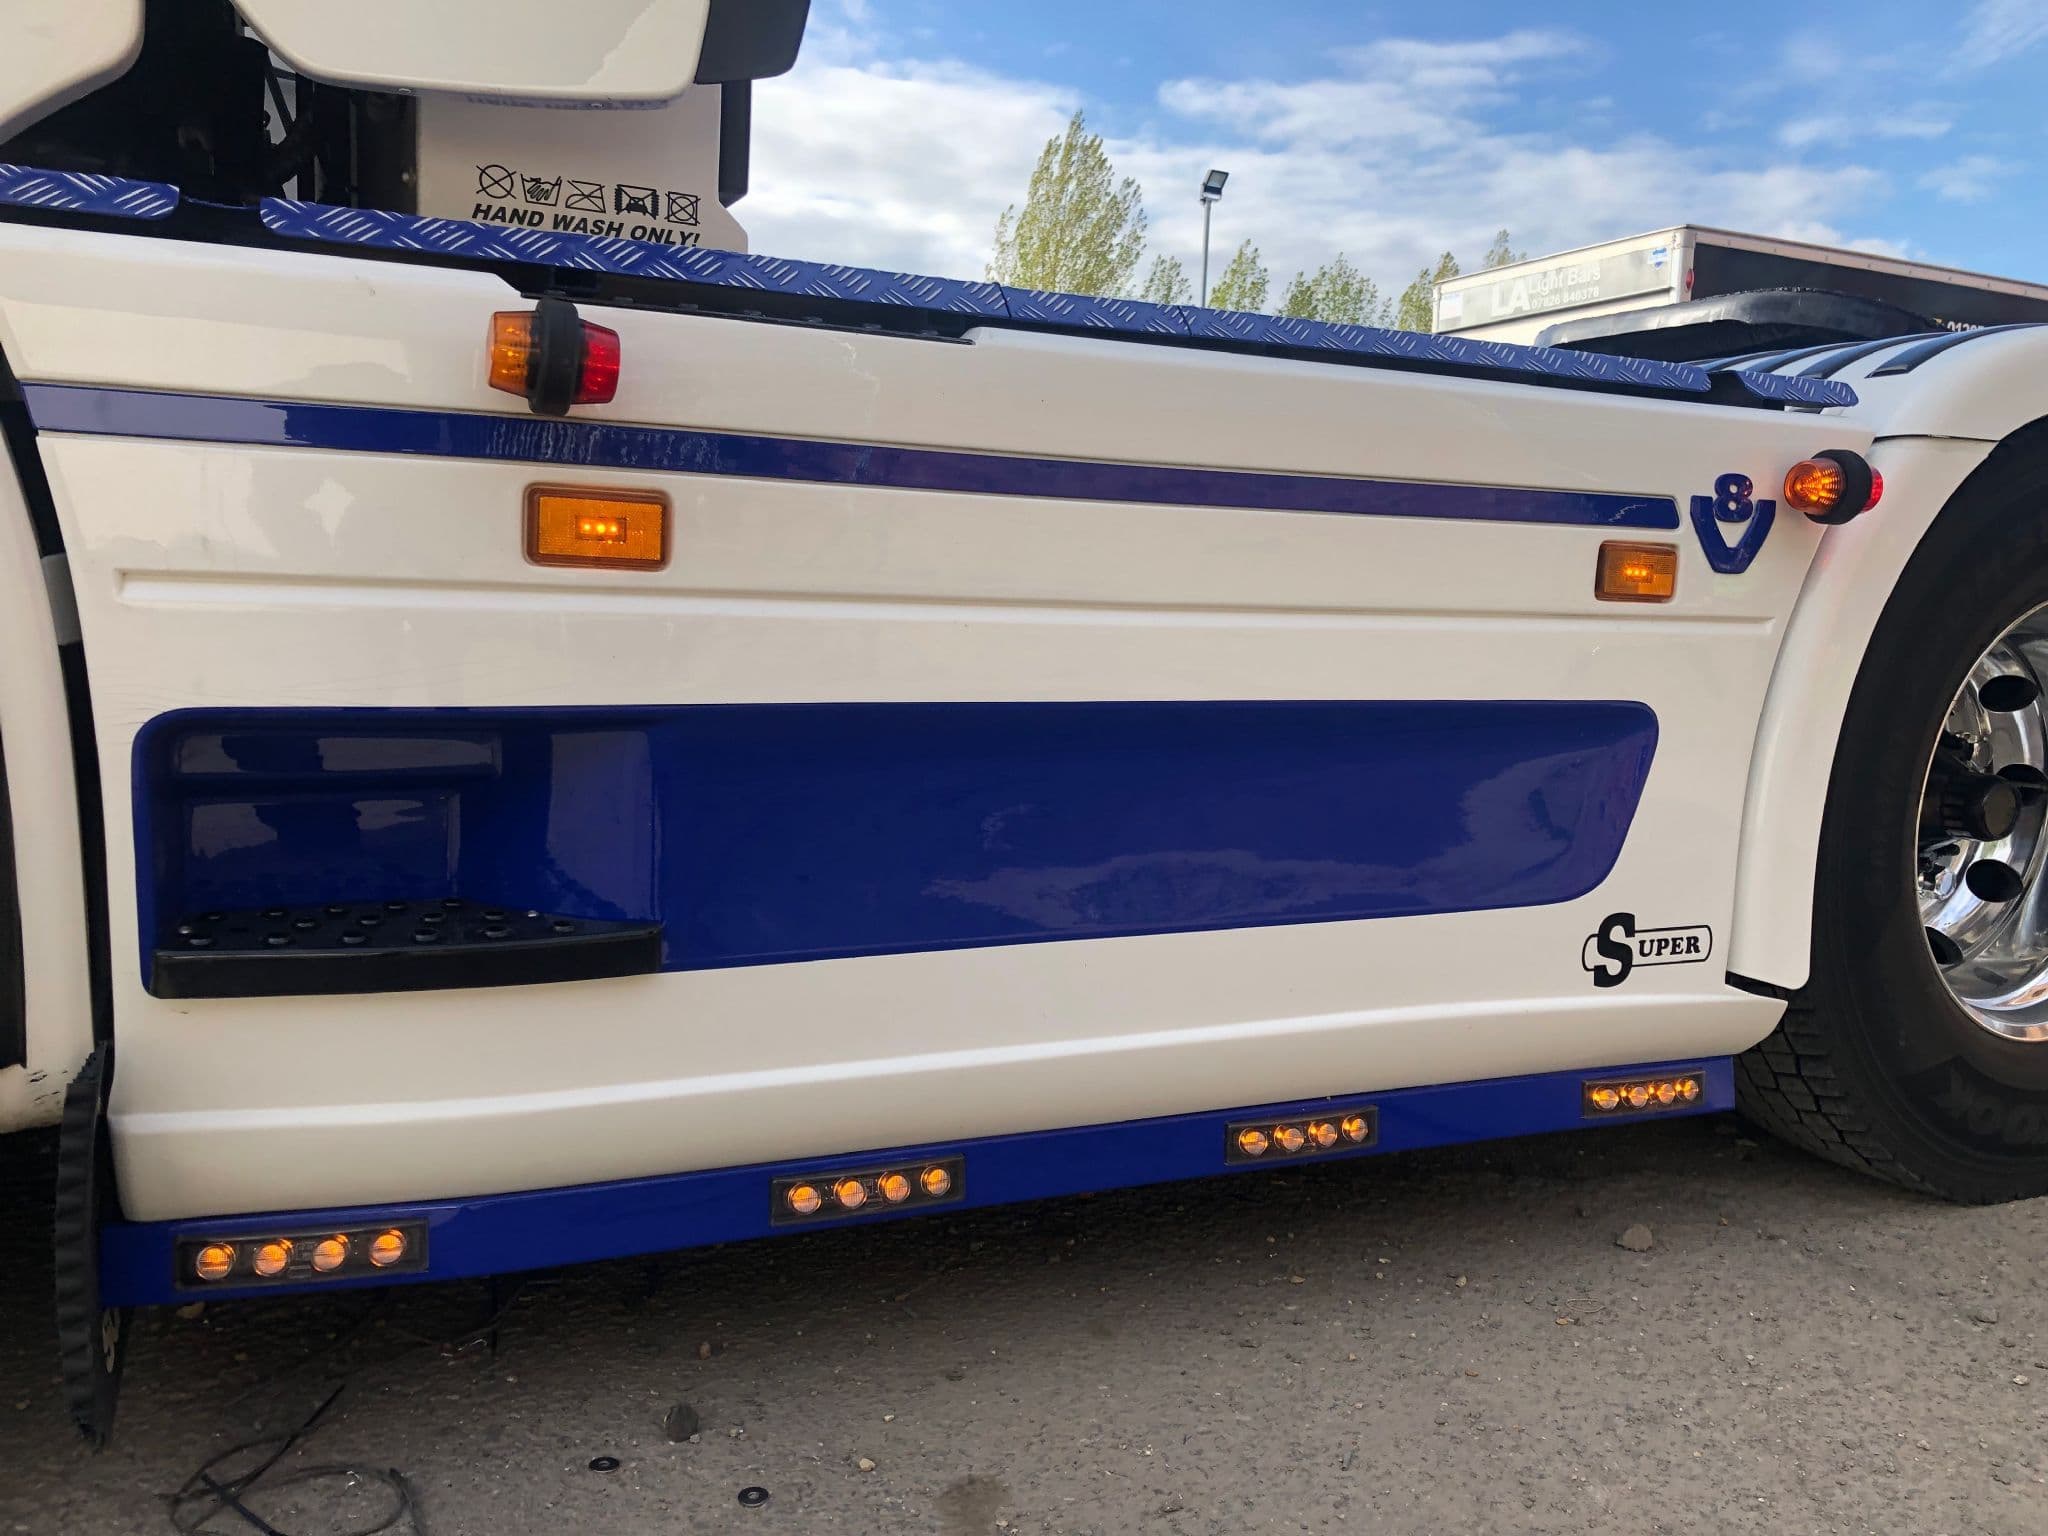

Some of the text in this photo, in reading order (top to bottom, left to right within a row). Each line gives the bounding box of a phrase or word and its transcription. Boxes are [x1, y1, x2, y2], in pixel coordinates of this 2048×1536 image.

[472, 203, 700, 247] HAND WASH ONLY!
[1491, 278, 1531, 316] LA
[1528, 265, 1600, 295] Light Bars
[1593, 912, 1701, 988] SUPER
